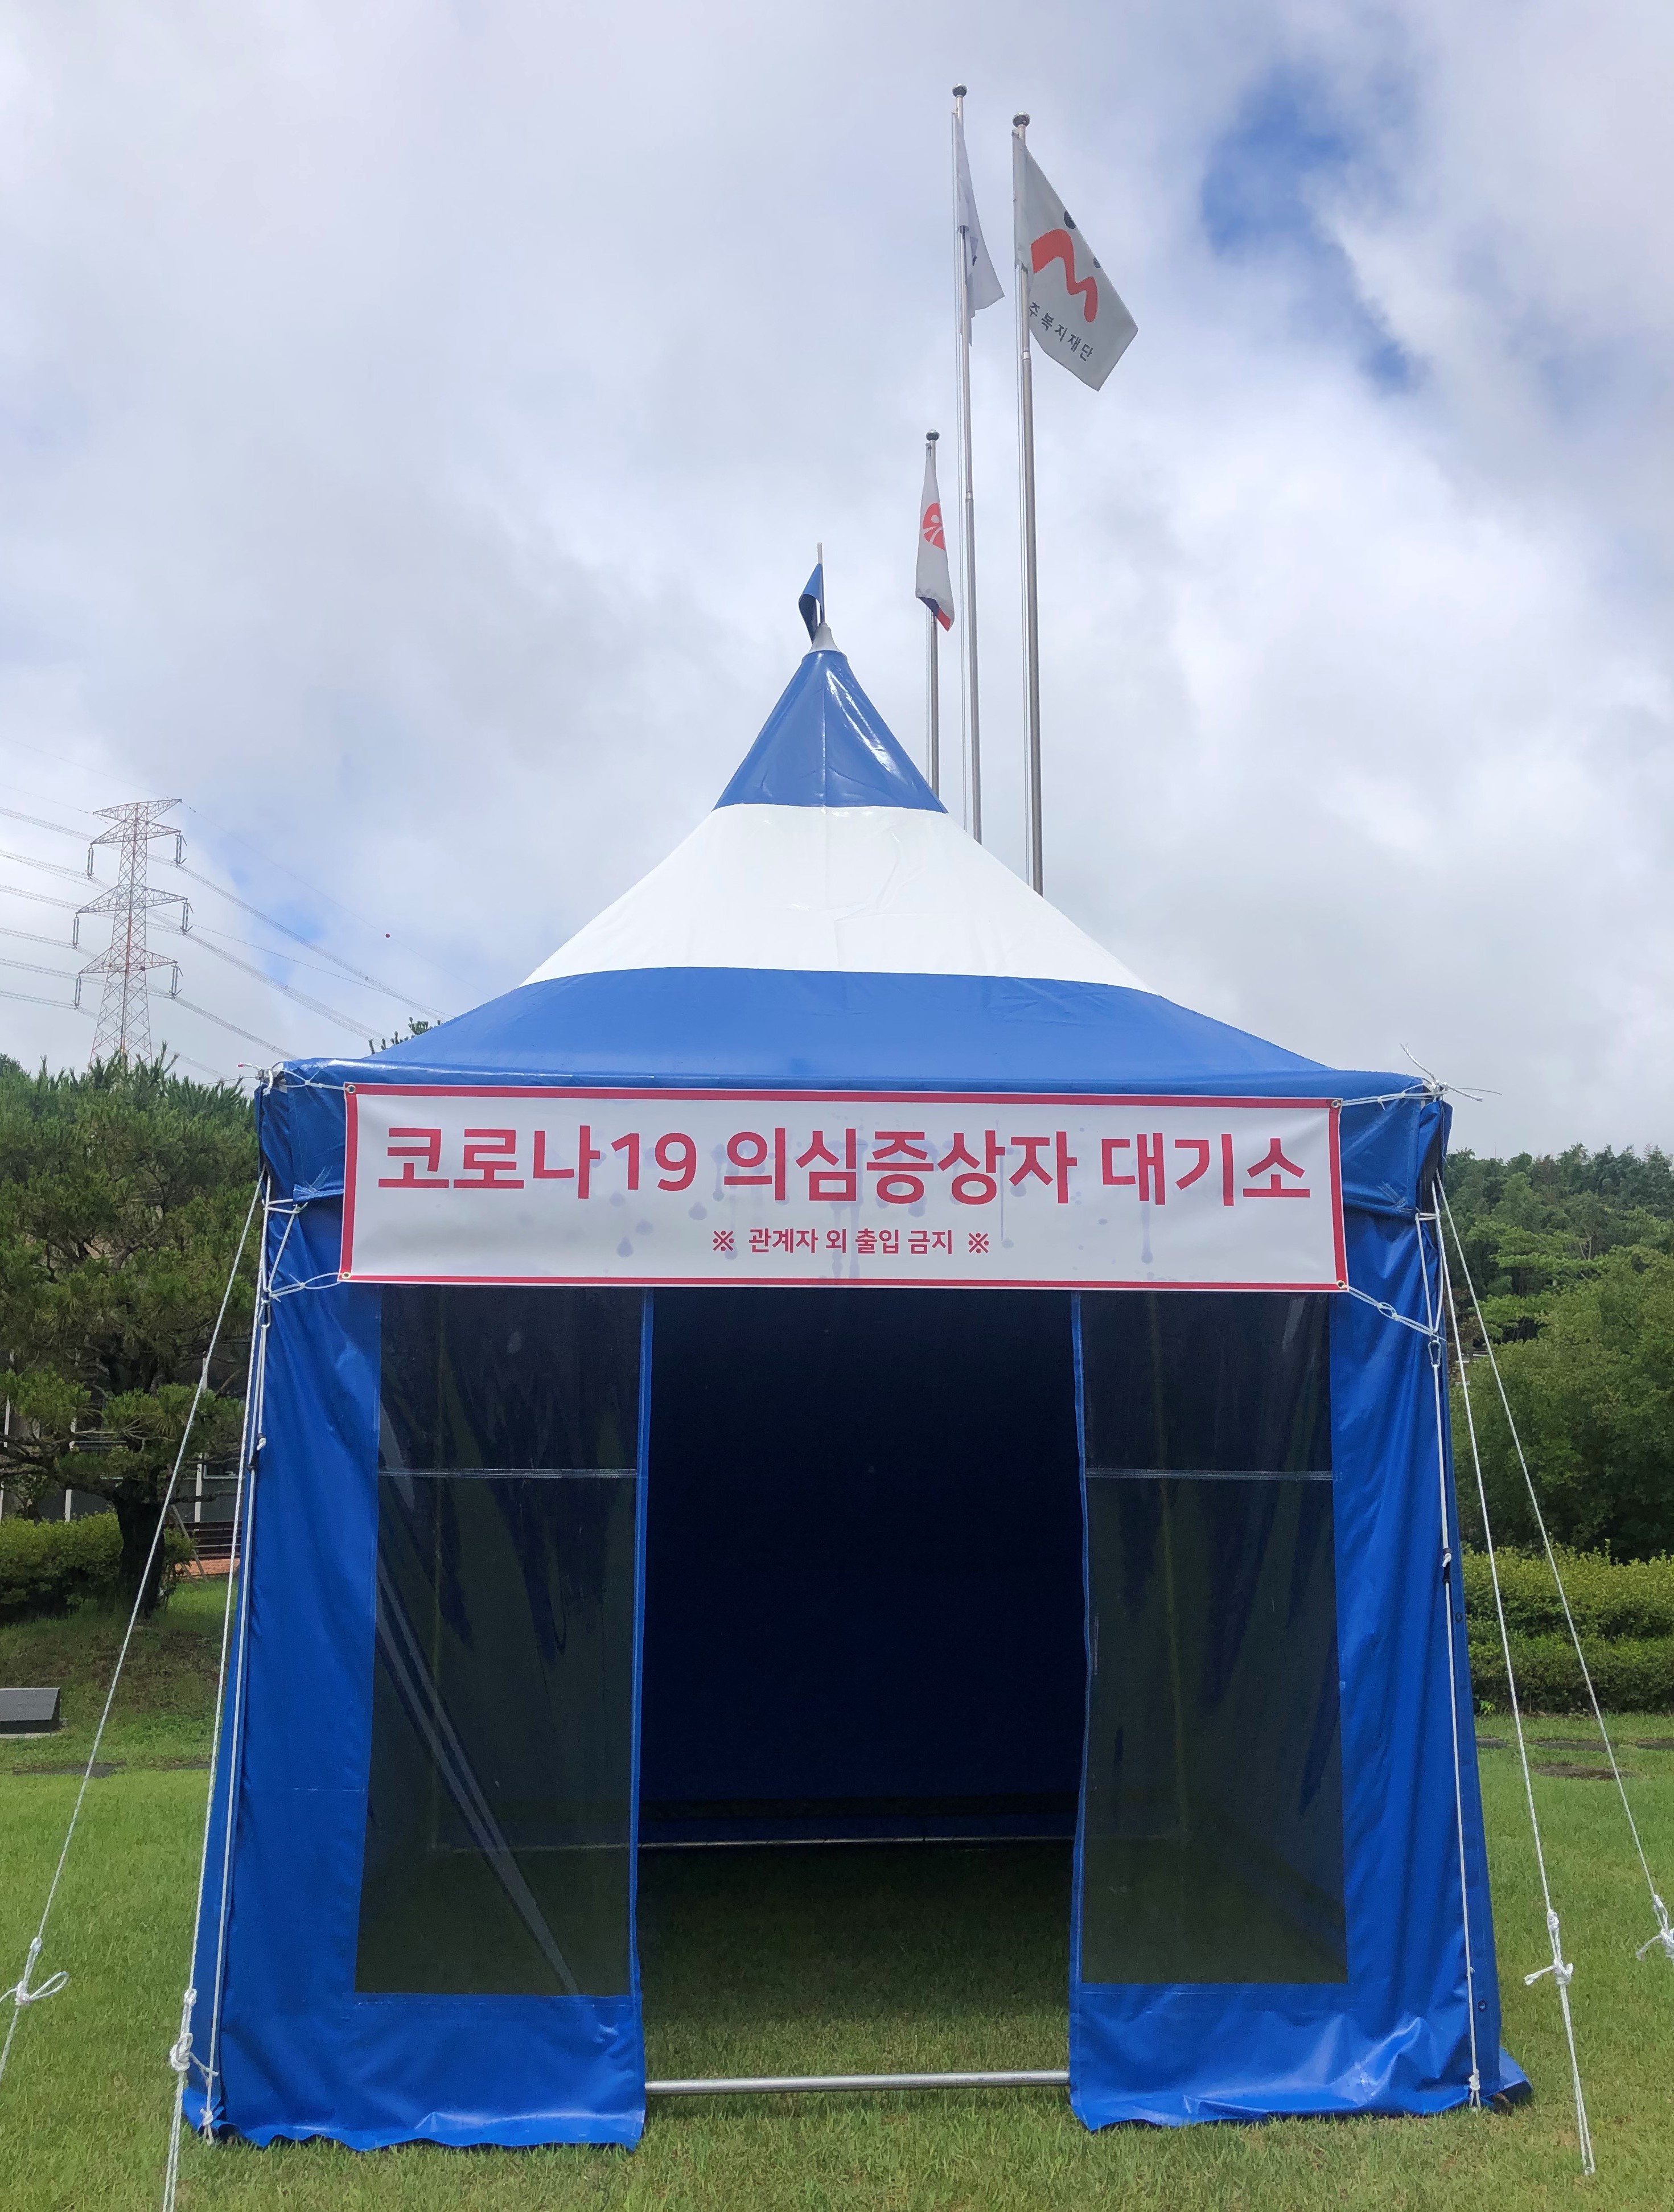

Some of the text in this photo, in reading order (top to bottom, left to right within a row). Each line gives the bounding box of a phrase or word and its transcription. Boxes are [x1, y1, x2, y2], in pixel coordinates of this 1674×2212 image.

[378, 1125, 1311, 1206] 코로나19 의심증상자 대기소
[748, 1228, 819, 1253] 관계자
[825, 1228, 847, 1253] 외
[855, 1228, 900, 1255] 출입
[907, 1230, 953, 1255] 금지
